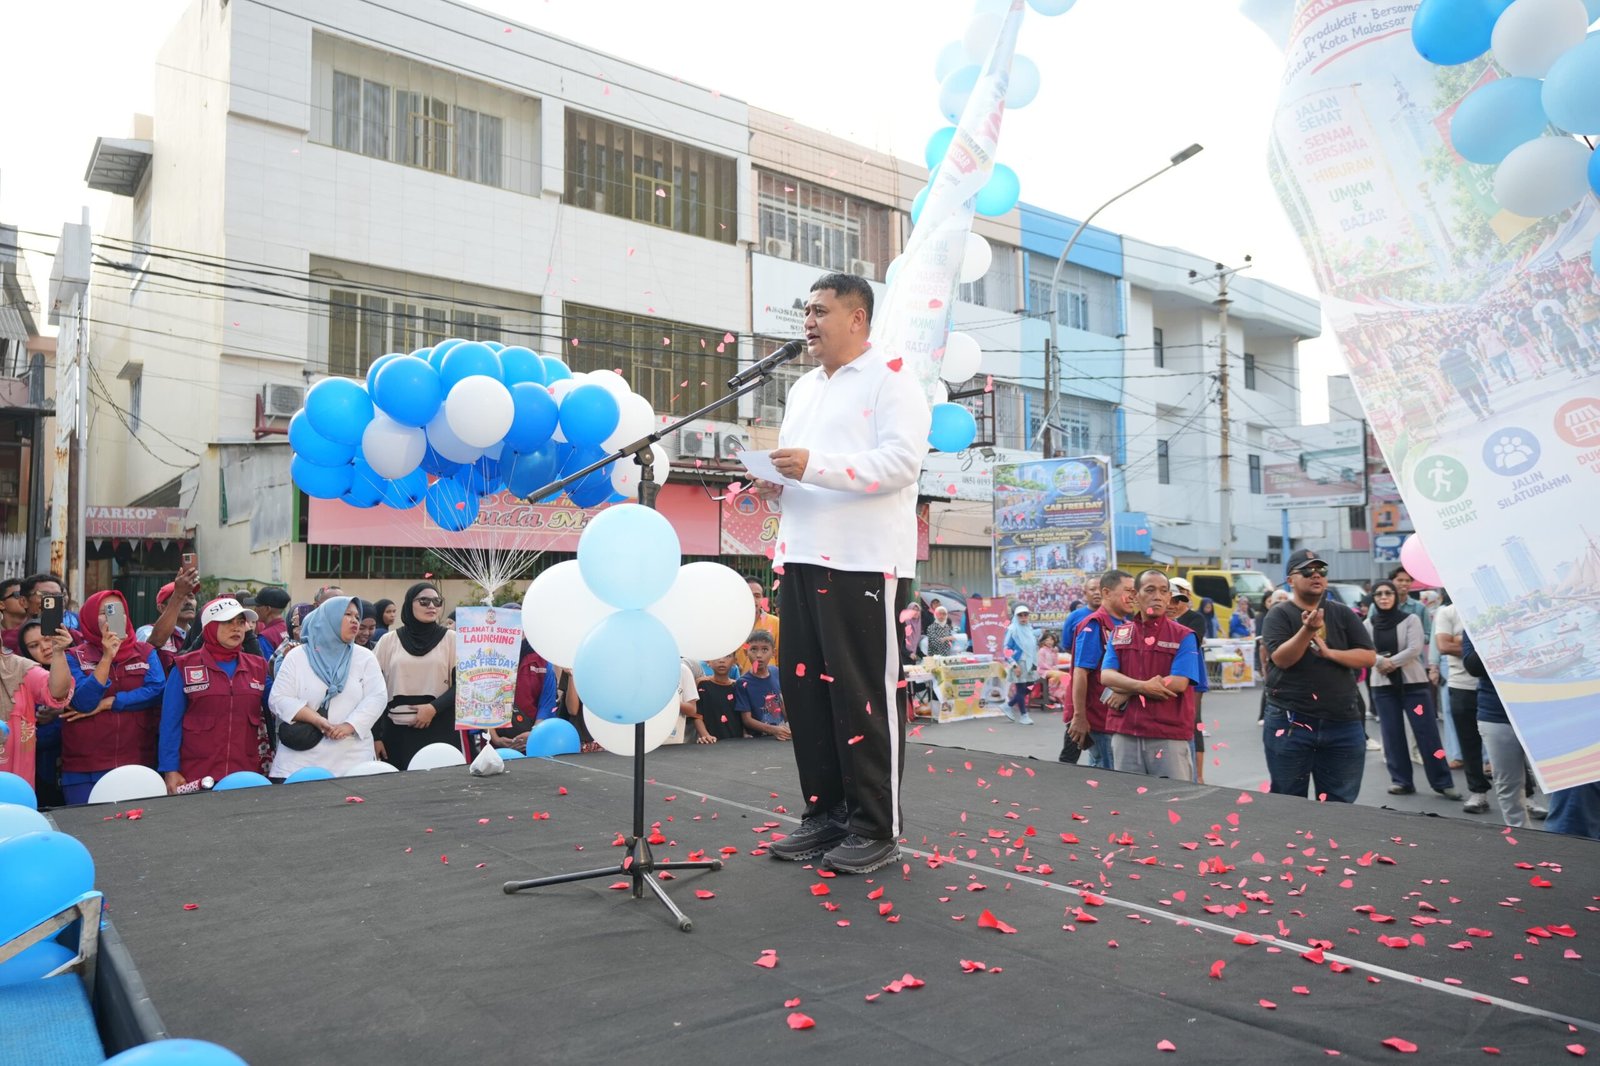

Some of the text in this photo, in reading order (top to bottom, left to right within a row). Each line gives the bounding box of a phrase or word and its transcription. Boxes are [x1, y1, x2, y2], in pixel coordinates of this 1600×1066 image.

[1303, 11, 1357, 49] Produktif
[1284, 17, 1406, 85] Untuk Kota Makassar
[1296, 96, 1340, 120] JALAN
[1300, 109, 1342, 132] SEHAT
[1304, 125, 1354, 149] SENAM
[1304, 138, 1369, 165] BERSAMA
[1313, 156, 1376, 182] HIBURAN
[1329, 180, 1374, 203] UMKM
[1353, 199, 1363, 212] &
[1340, 208, 1387, 232] BAZAR
[1497, 473, 1572, 510] SILATURAHMI
[1511, 471, 1544, 491] JALIN
[1436, 499, 1473, 518] HIDUP
[1442, 510, 1478, 530] SEHAT
[92, 520, 146, 536] KIKI
[459, 626, 489, 634] SELAMAT
[496, 627, 521, 636] SUKSES
[463, 633, 515, 645] LAUNCHING
[459, 656, 517, 671] CAR FREE DAY
